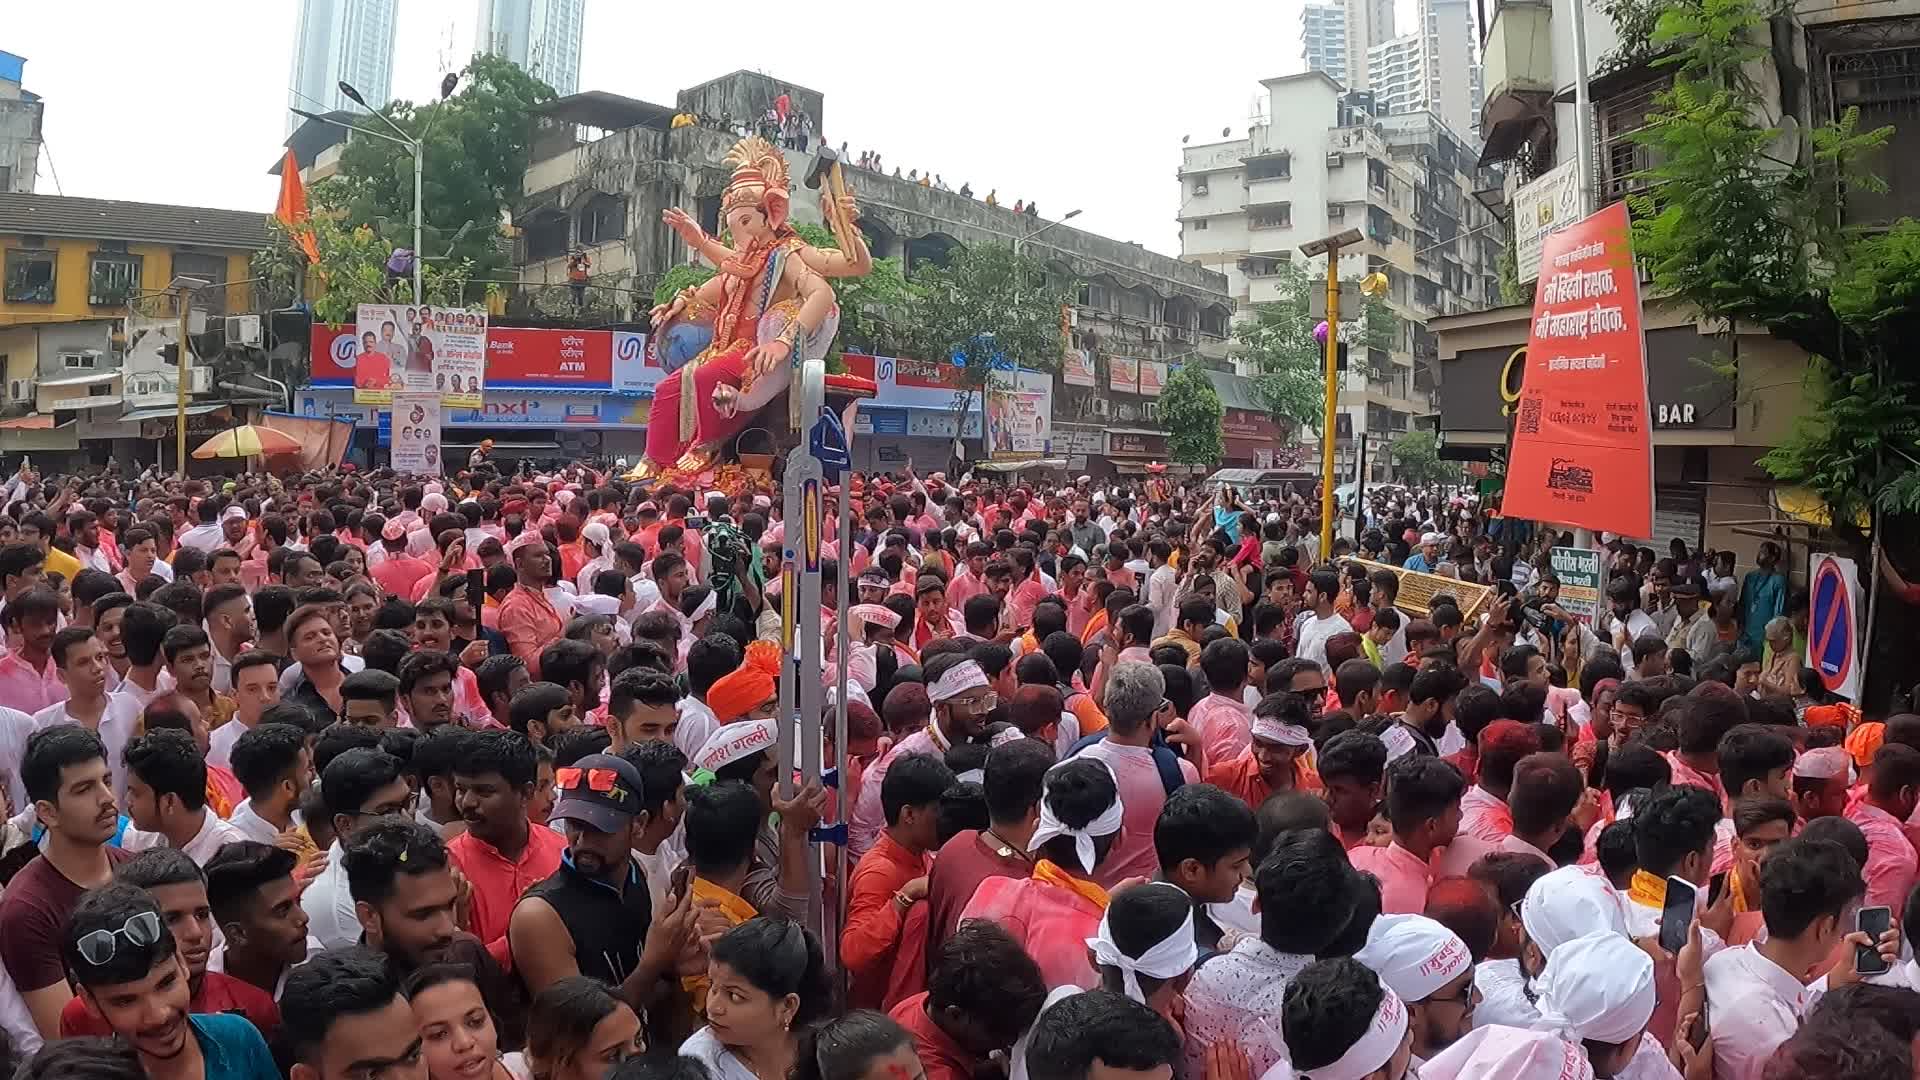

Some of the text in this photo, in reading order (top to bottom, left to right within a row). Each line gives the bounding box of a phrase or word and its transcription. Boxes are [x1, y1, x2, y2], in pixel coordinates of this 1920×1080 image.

[1535, 311, 1549, 339] मी
[560, 362, 585, 371] ATM
[1659, 403, 1695, 424] BAR
[1551, 549, 1598, 574] पोलीस भरती
[731, 725, 771, 750] गल्ली
